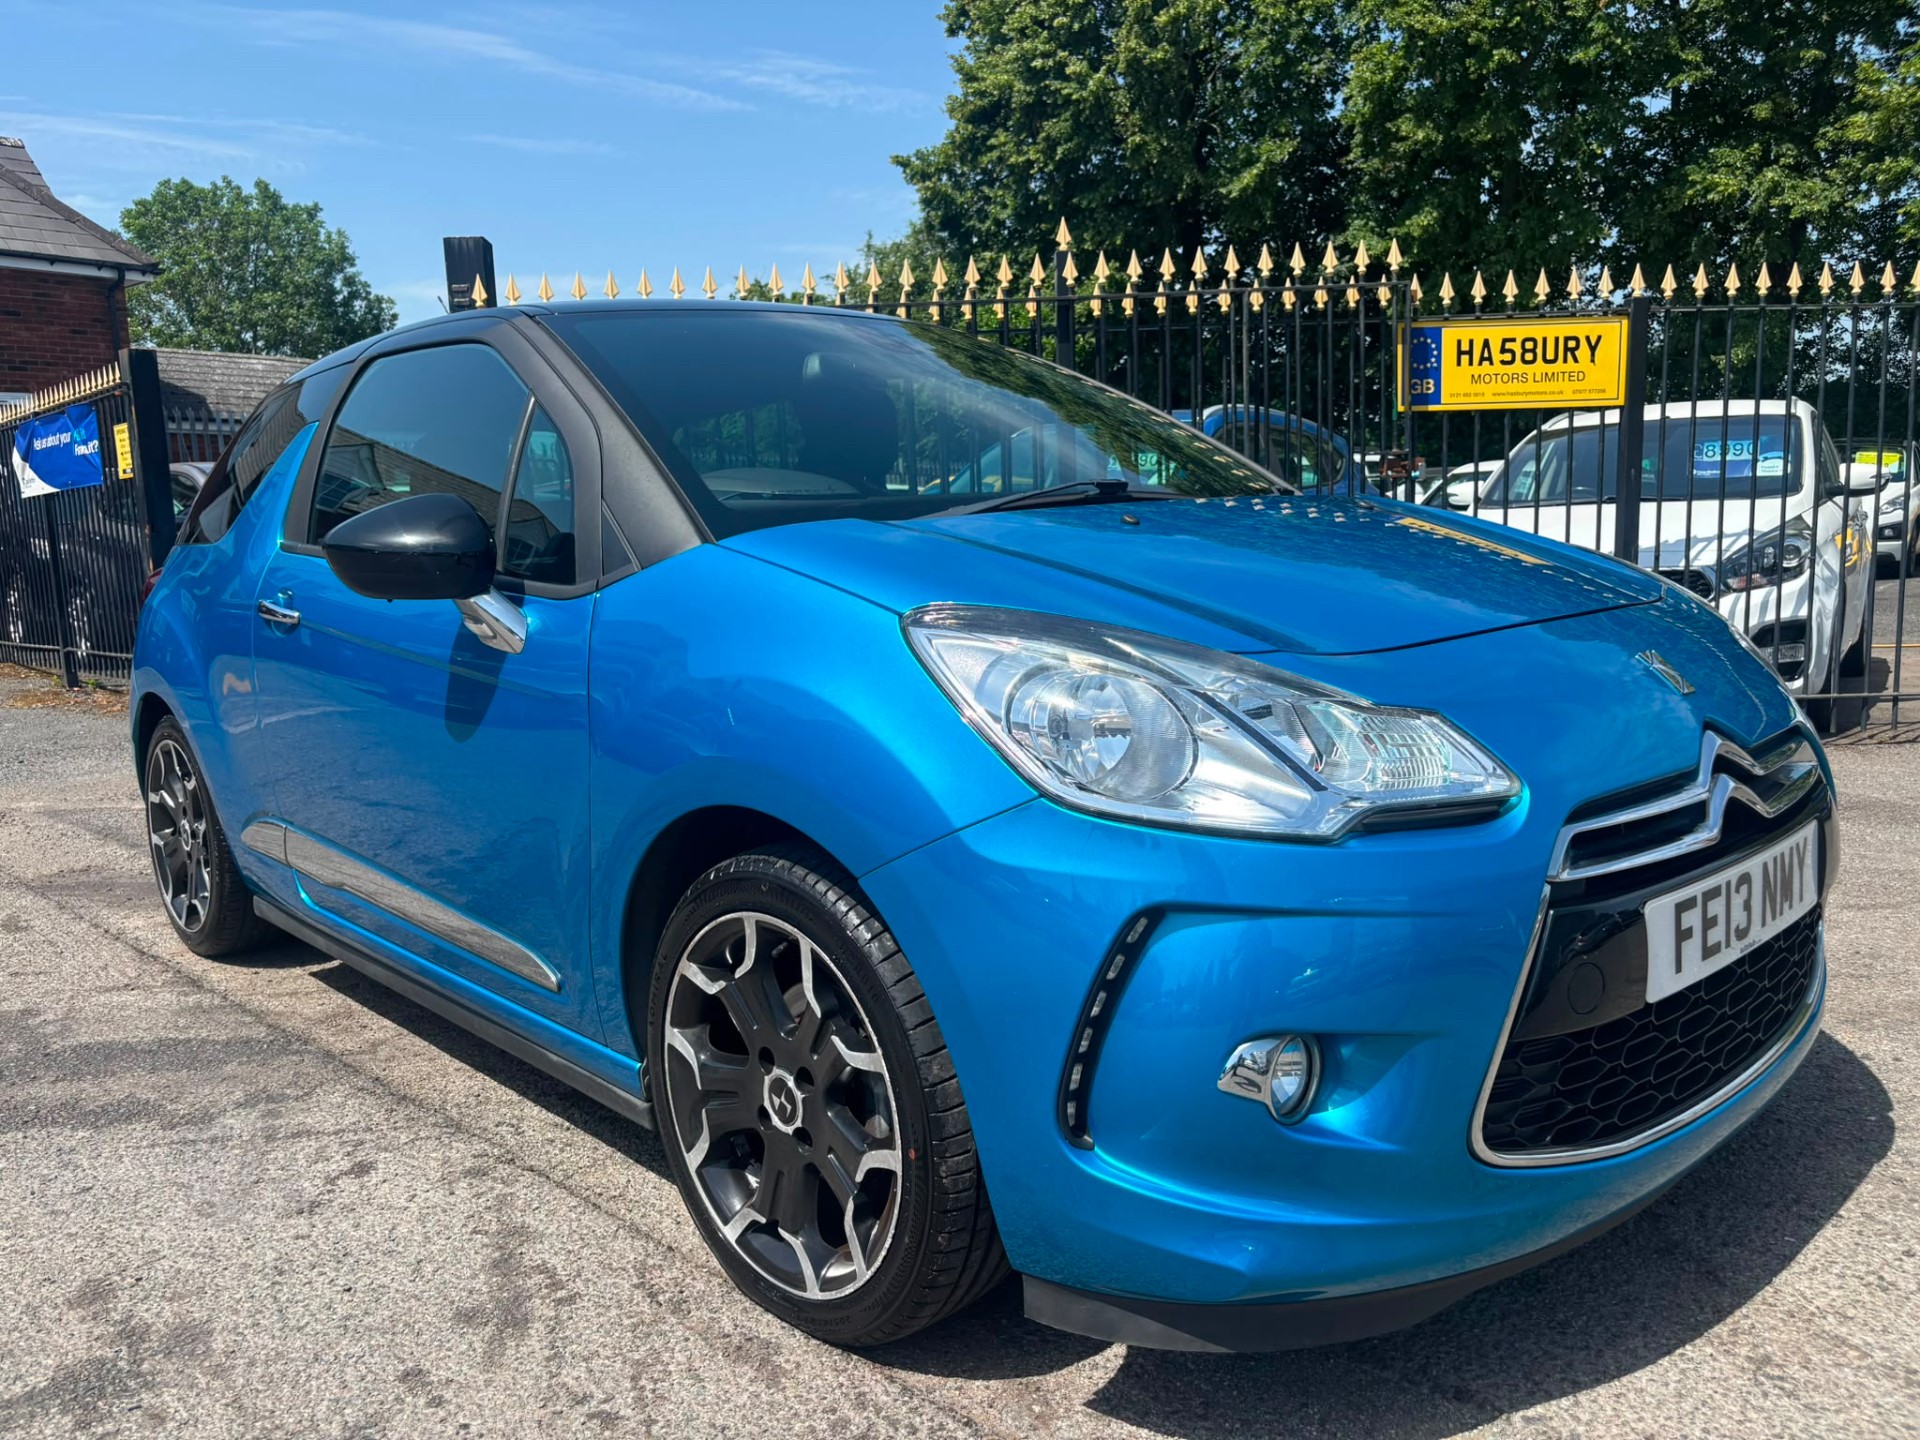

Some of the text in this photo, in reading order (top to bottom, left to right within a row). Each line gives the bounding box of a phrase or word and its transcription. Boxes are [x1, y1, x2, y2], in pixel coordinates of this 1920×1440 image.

[1470, 370, 1586, 385] MOTORS LIMITED
[1410, 378, 1435, 394] GB
[1674, 836, 1808, 975] FE13 NMY
